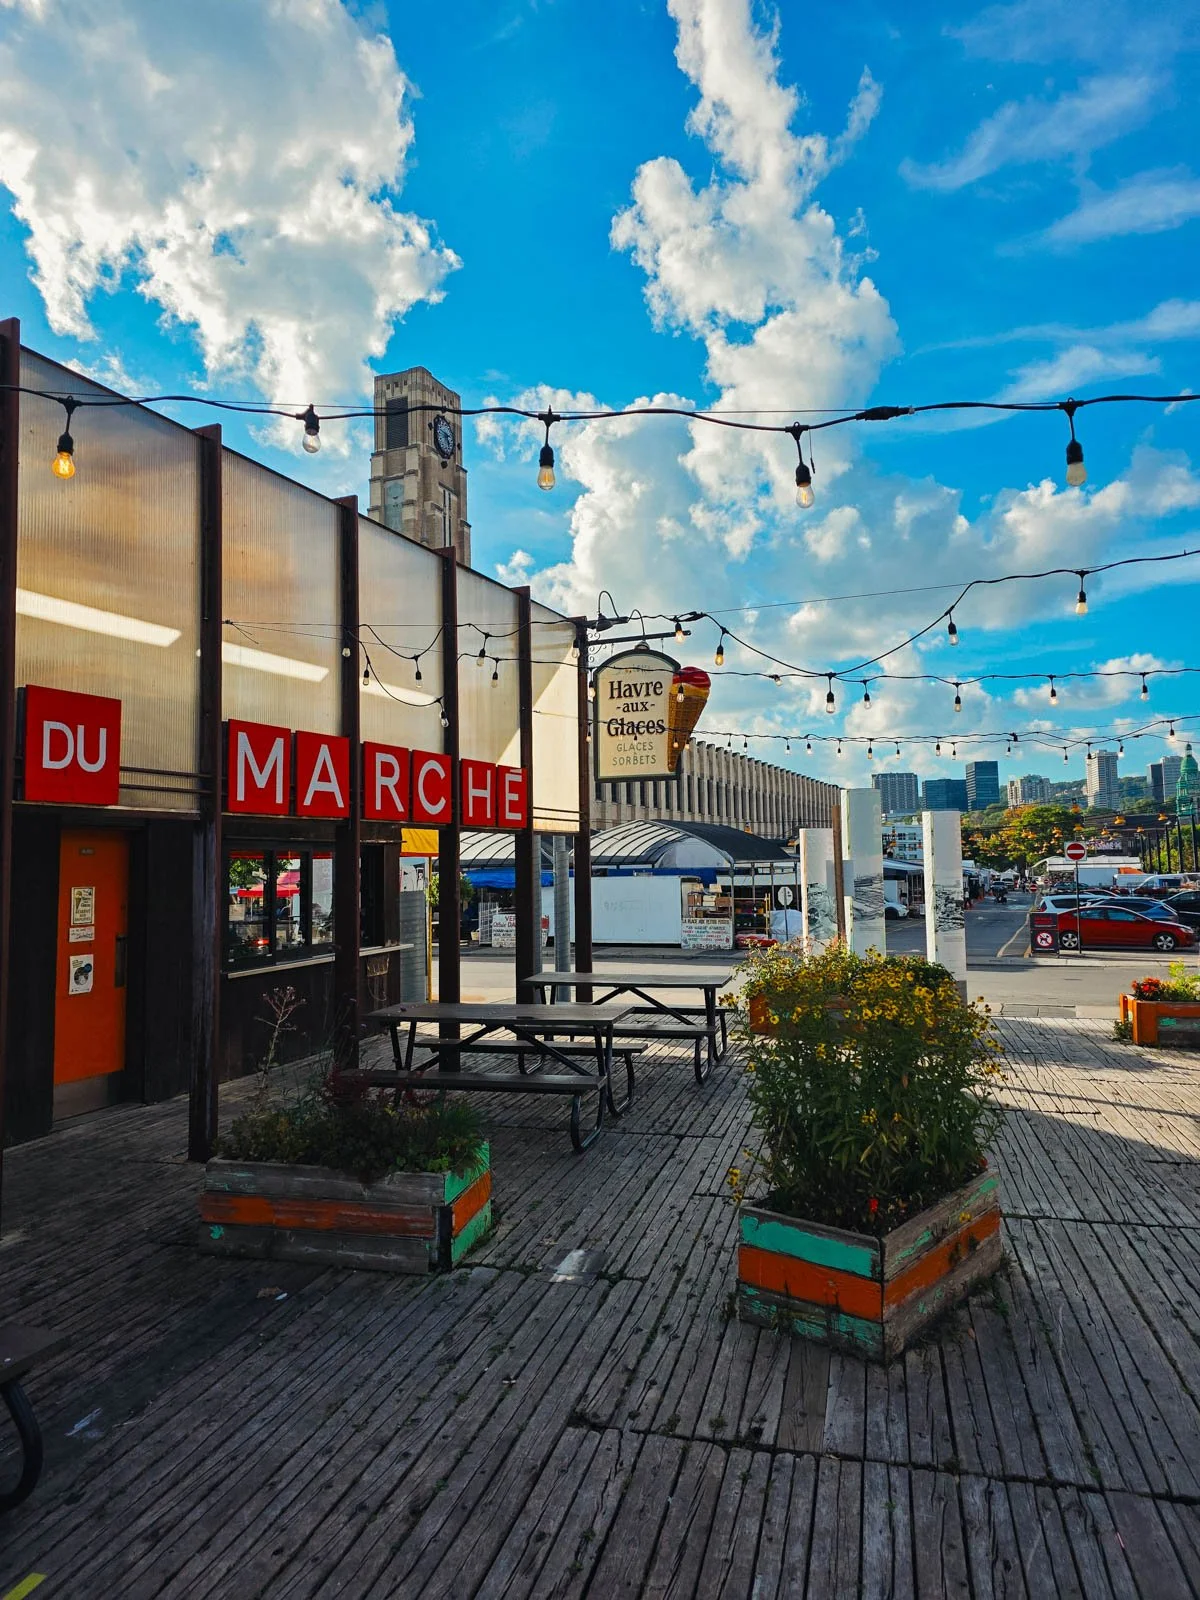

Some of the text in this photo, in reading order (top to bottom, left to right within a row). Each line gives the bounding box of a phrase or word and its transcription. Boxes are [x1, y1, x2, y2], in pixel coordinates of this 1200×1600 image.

[608, 680, 664, 700] Havre
[606, 717, 667, 737] Glaces
[616, 741, 654, 753] GLACES
[612, 754, 657, 766] SORBETS
[41, 720, 523, 821] DU MARCHÉ
